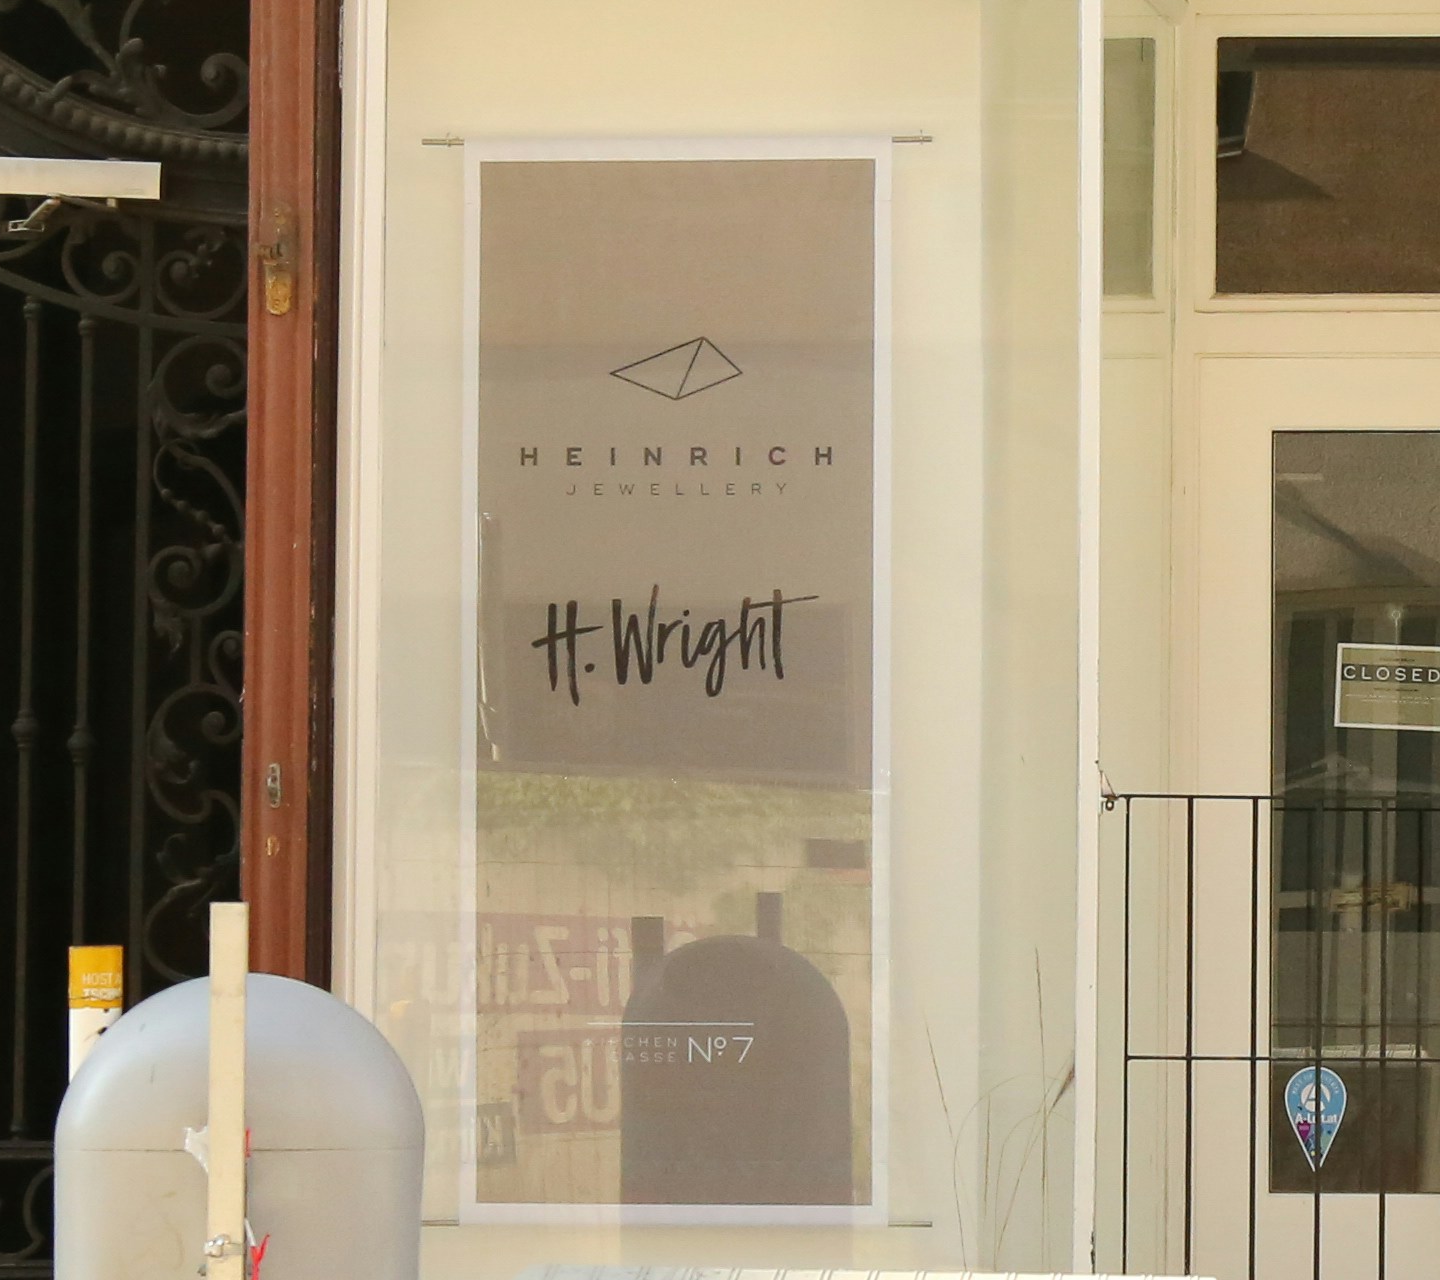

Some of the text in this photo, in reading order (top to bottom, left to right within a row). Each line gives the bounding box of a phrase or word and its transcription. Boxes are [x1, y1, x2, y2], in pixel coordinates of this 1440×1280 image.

[520, 446, 833, 467] HEINRICH
[566, 483, 788, 496] JEWELLERY
[531, 583, 820, 707] H. Wright
